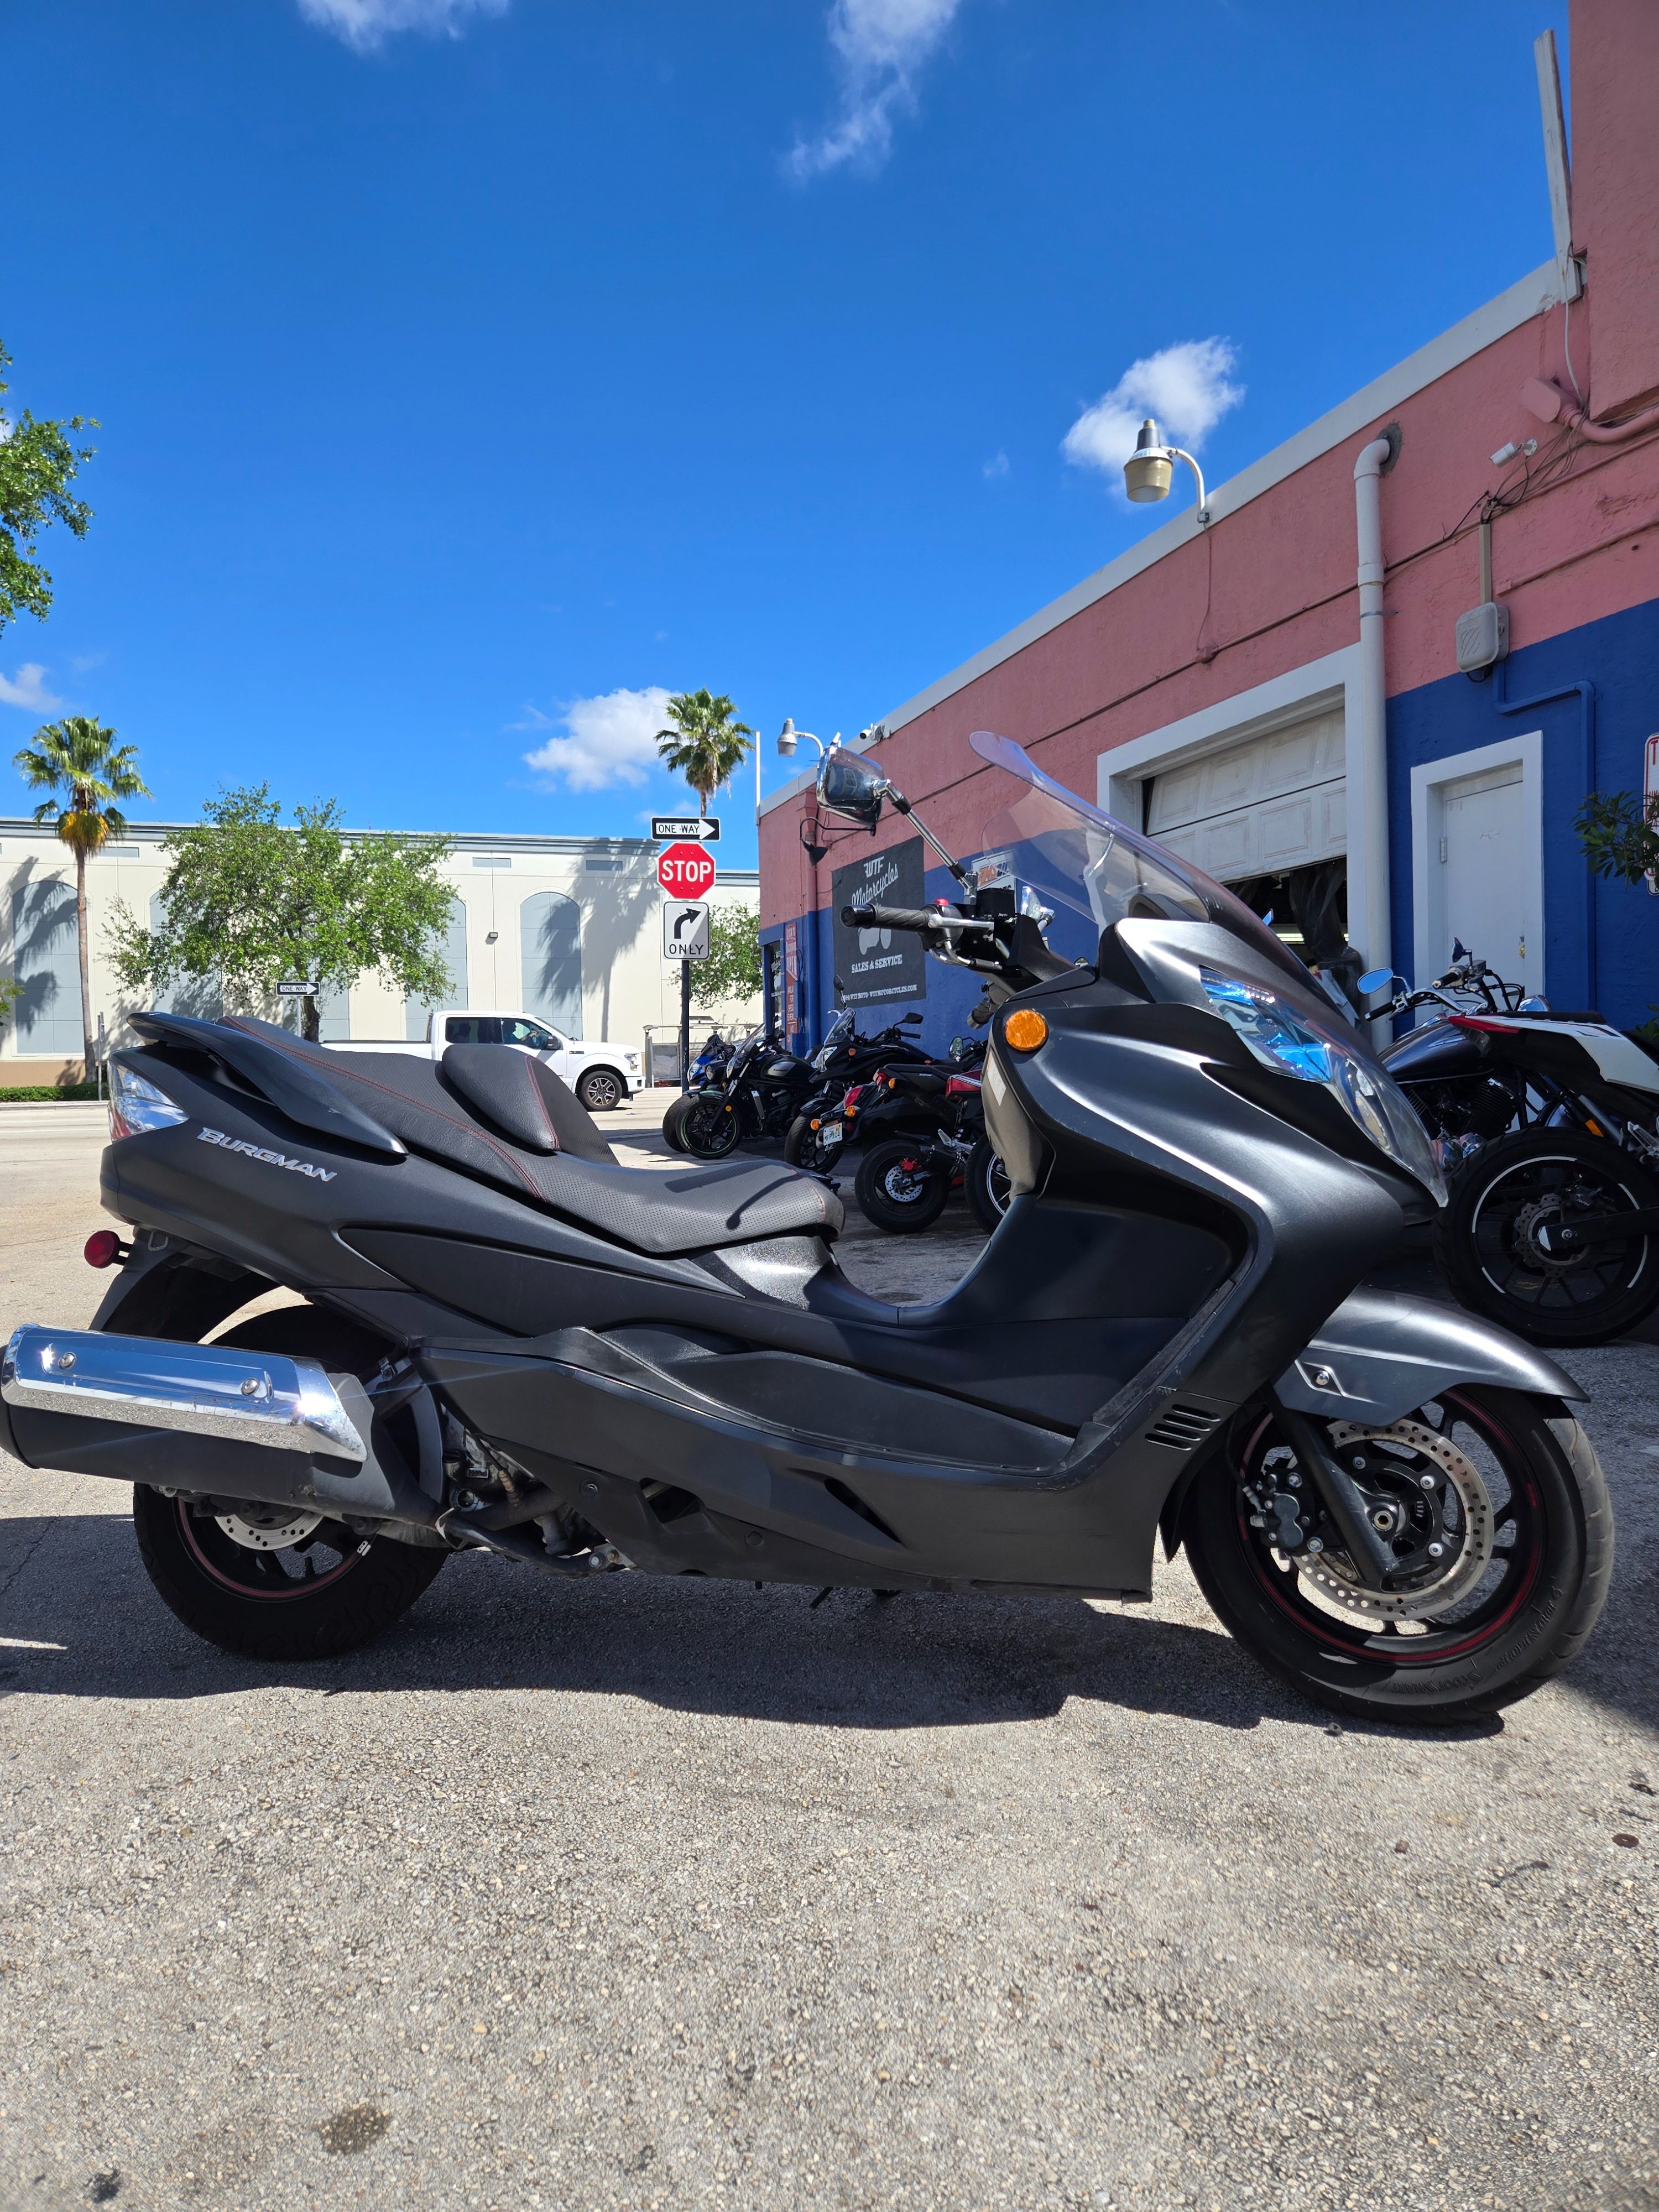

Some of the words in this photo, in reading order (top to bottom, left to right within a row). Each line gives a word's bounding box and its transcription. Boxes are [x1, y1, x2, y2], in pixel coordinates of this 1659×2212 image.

[658, 824, 676, 833] ONE
[681, 825, 700, 834] WAY
[661, 860, 712, 883] STOP
[852, 862, 899, 905] Motorcycles
[669, 943, 704, 955] ONLY
[851, 961, 869, 974] SALES
[869, 960, 874, 970] &
[874, 954, 902, 969] SERVICE
[196, 1126, 337, 1182] BURGMAN
